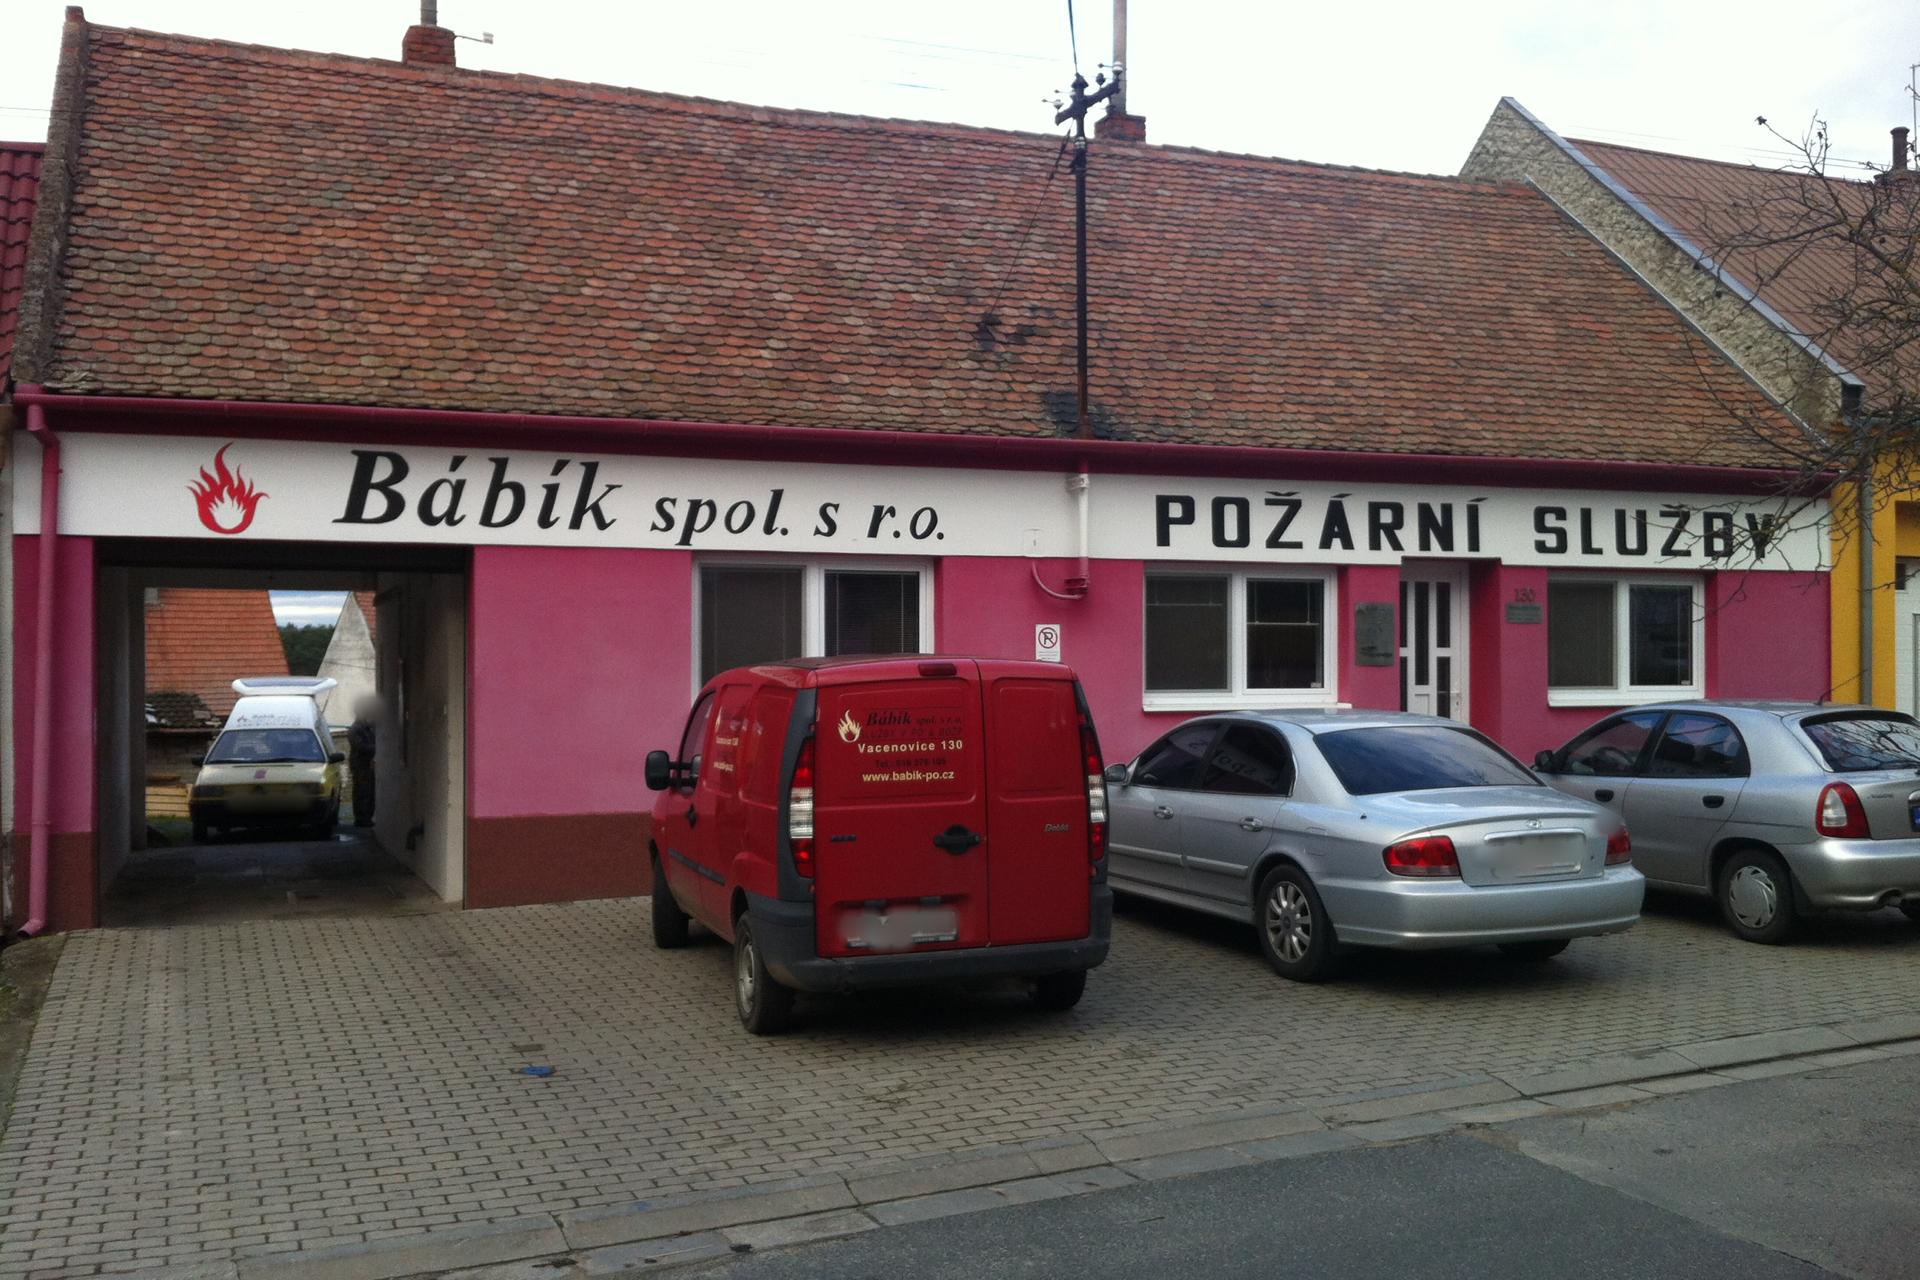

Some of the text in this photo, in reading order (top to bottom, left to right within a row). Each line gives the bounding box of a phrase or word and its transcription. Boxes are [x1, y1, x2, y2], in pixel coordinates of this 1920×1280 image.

[332, 450, 945, 546] Bábík spol. s r.o.
[1155, 491, 1775, 559] POŽÁRNÍ SLUŽBY
[858, 740, 963, 753] Vacenovice 130
[862, 771, 955, 782] www.babik-po.cz
